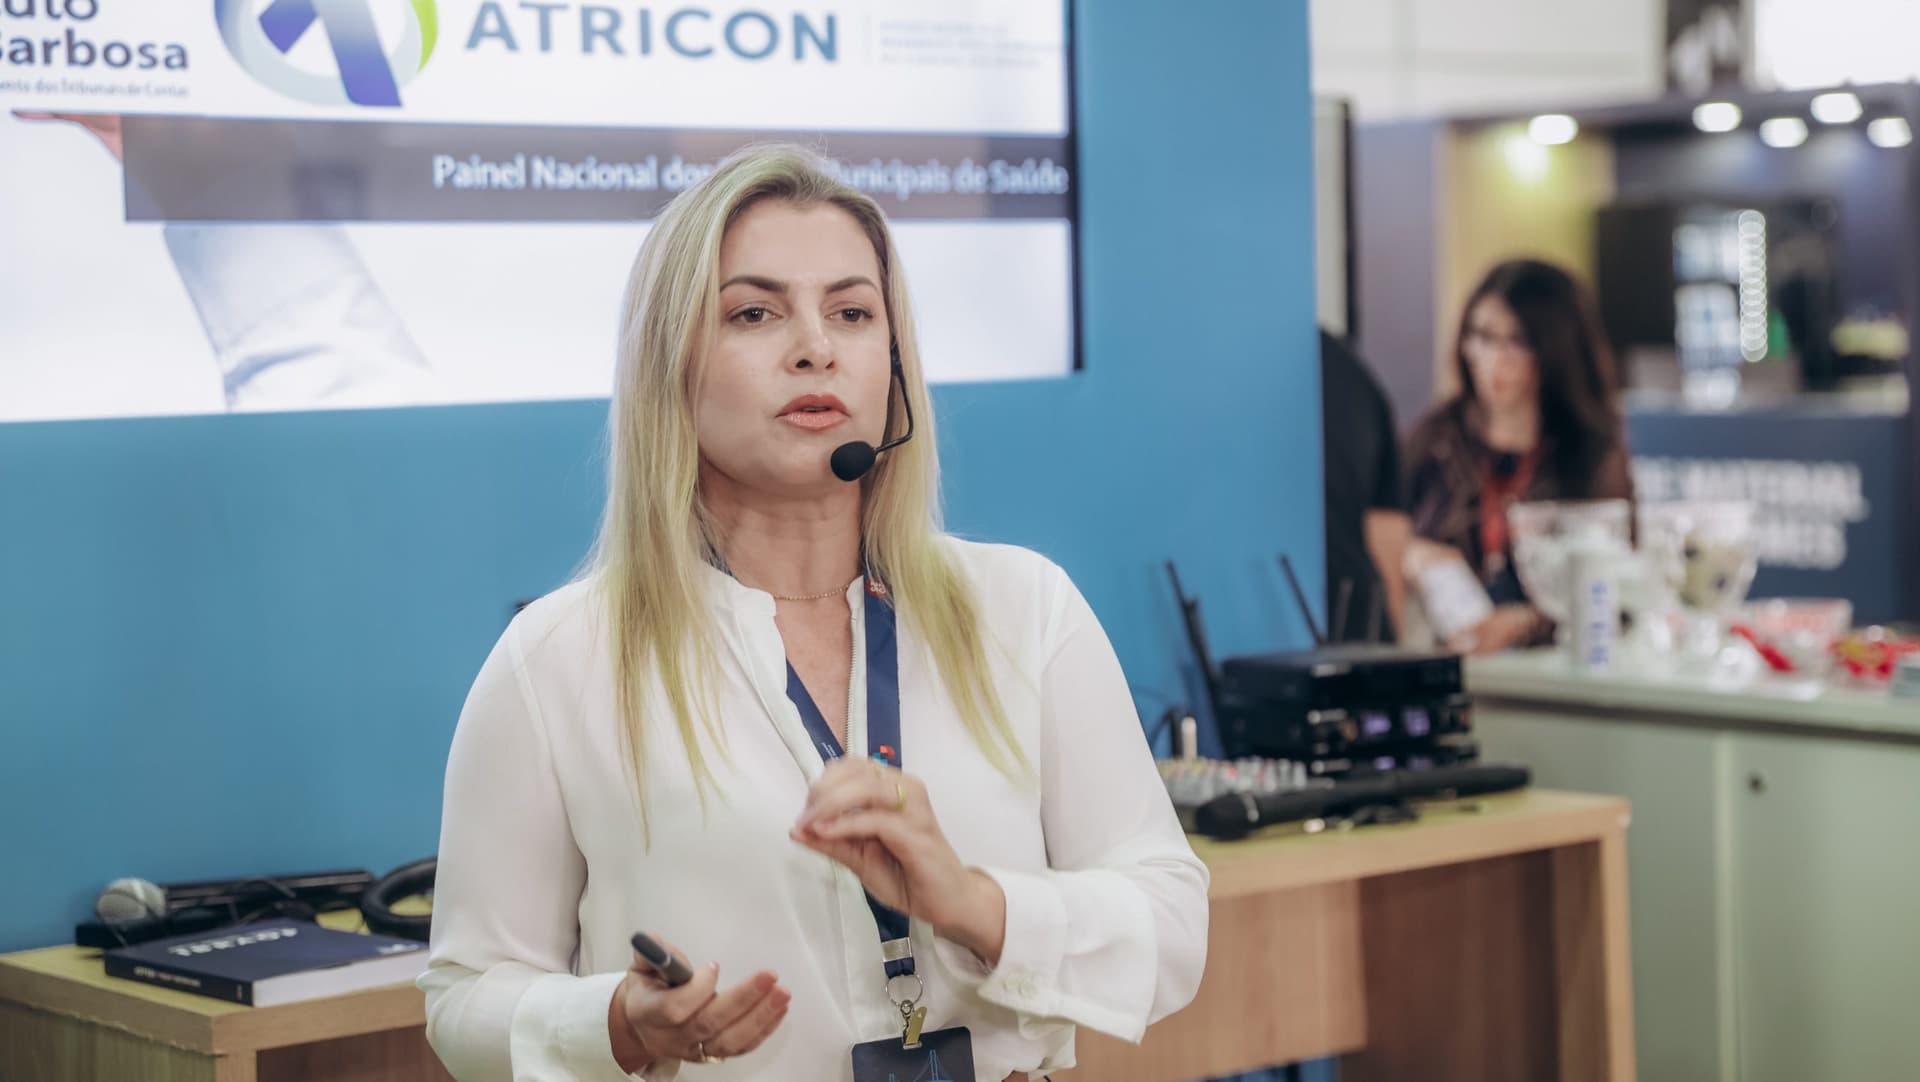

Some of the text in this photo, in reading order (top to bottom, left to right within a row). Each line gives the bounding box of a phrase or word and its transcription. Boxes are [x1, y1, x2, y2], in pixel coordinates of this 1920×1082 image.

[0, 0, 99, 20] uto
[0, 28, 188, 69] arbosa
[464, 0, 839, 62] ATRICON
[432, 153, 526, 190] Painel
[531, 154, 657, 190] Nacional
[952, 157, 987, 194] de
[988, 157, 1069, 194] Saúde
